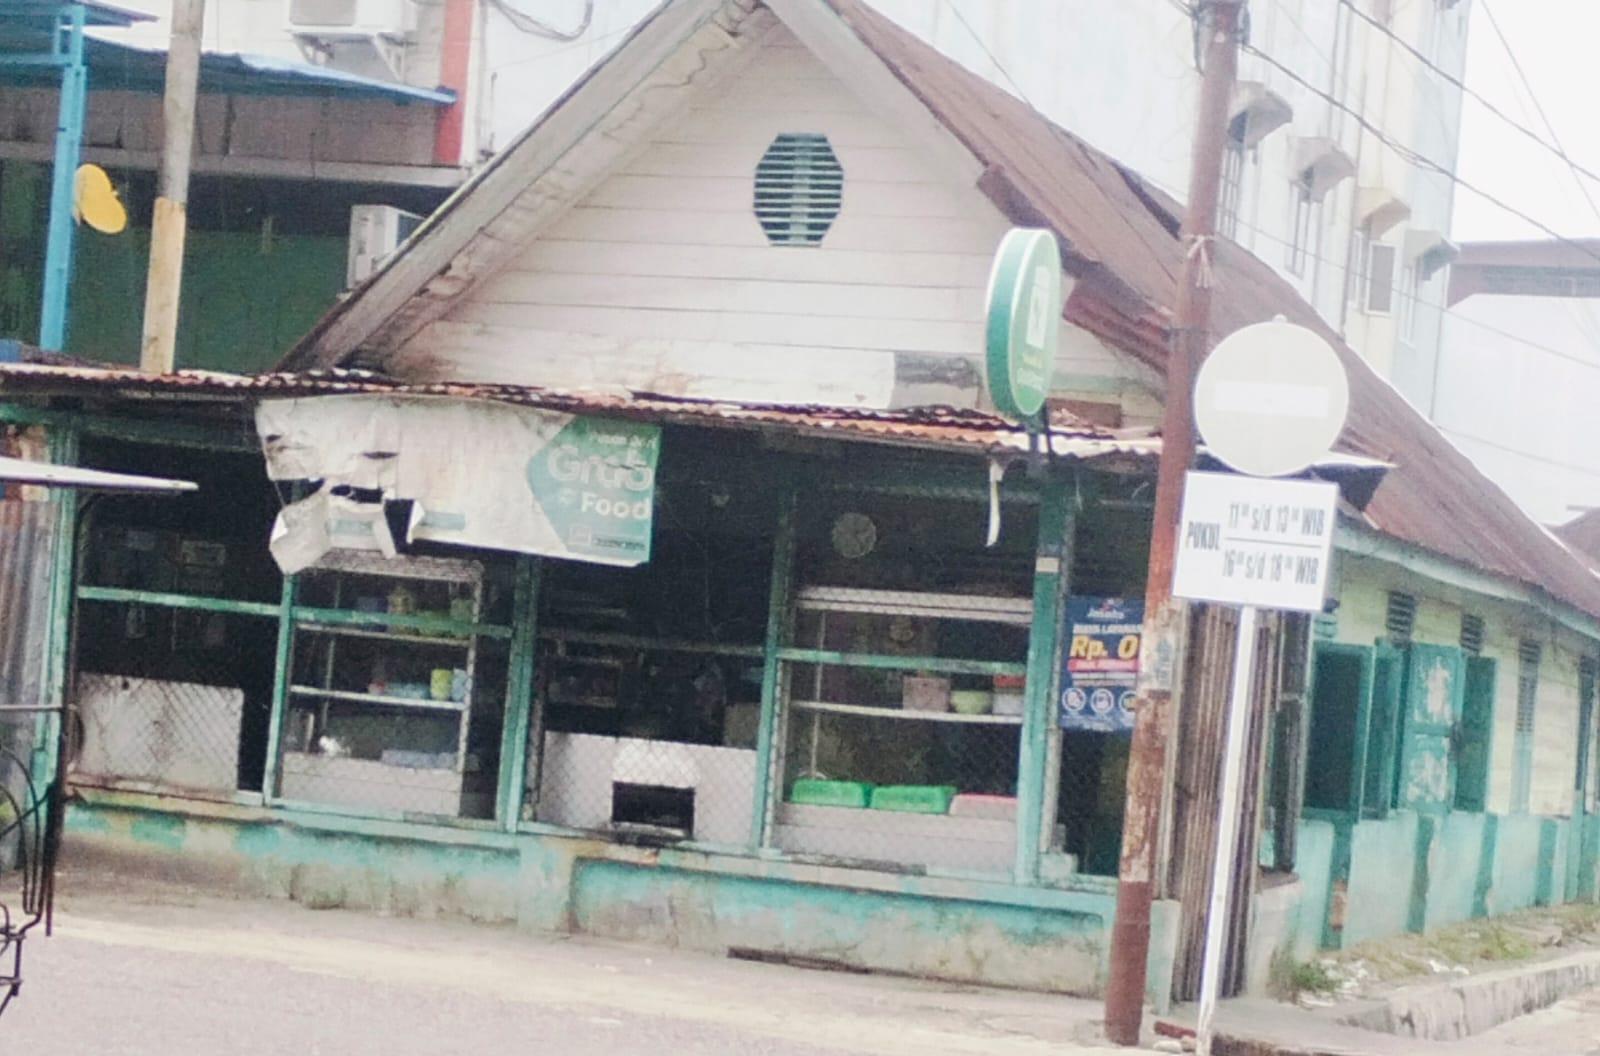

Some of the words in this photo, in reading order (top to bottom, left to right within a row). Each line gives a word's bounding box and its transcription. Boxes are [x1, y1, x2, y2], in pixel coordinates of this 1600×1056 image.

[580, 491, 651, 519] Food
[1185, 520, 1220, 550] PUKUL
[1251, 505, 1272, 532] s/d
[1301, 509, 1325, 536] WIB
[1244, 552, 1266, 579] s/d
[1295, 556, 1319, 584] WIB
[1069, 635, 1108, 660] Rp.
